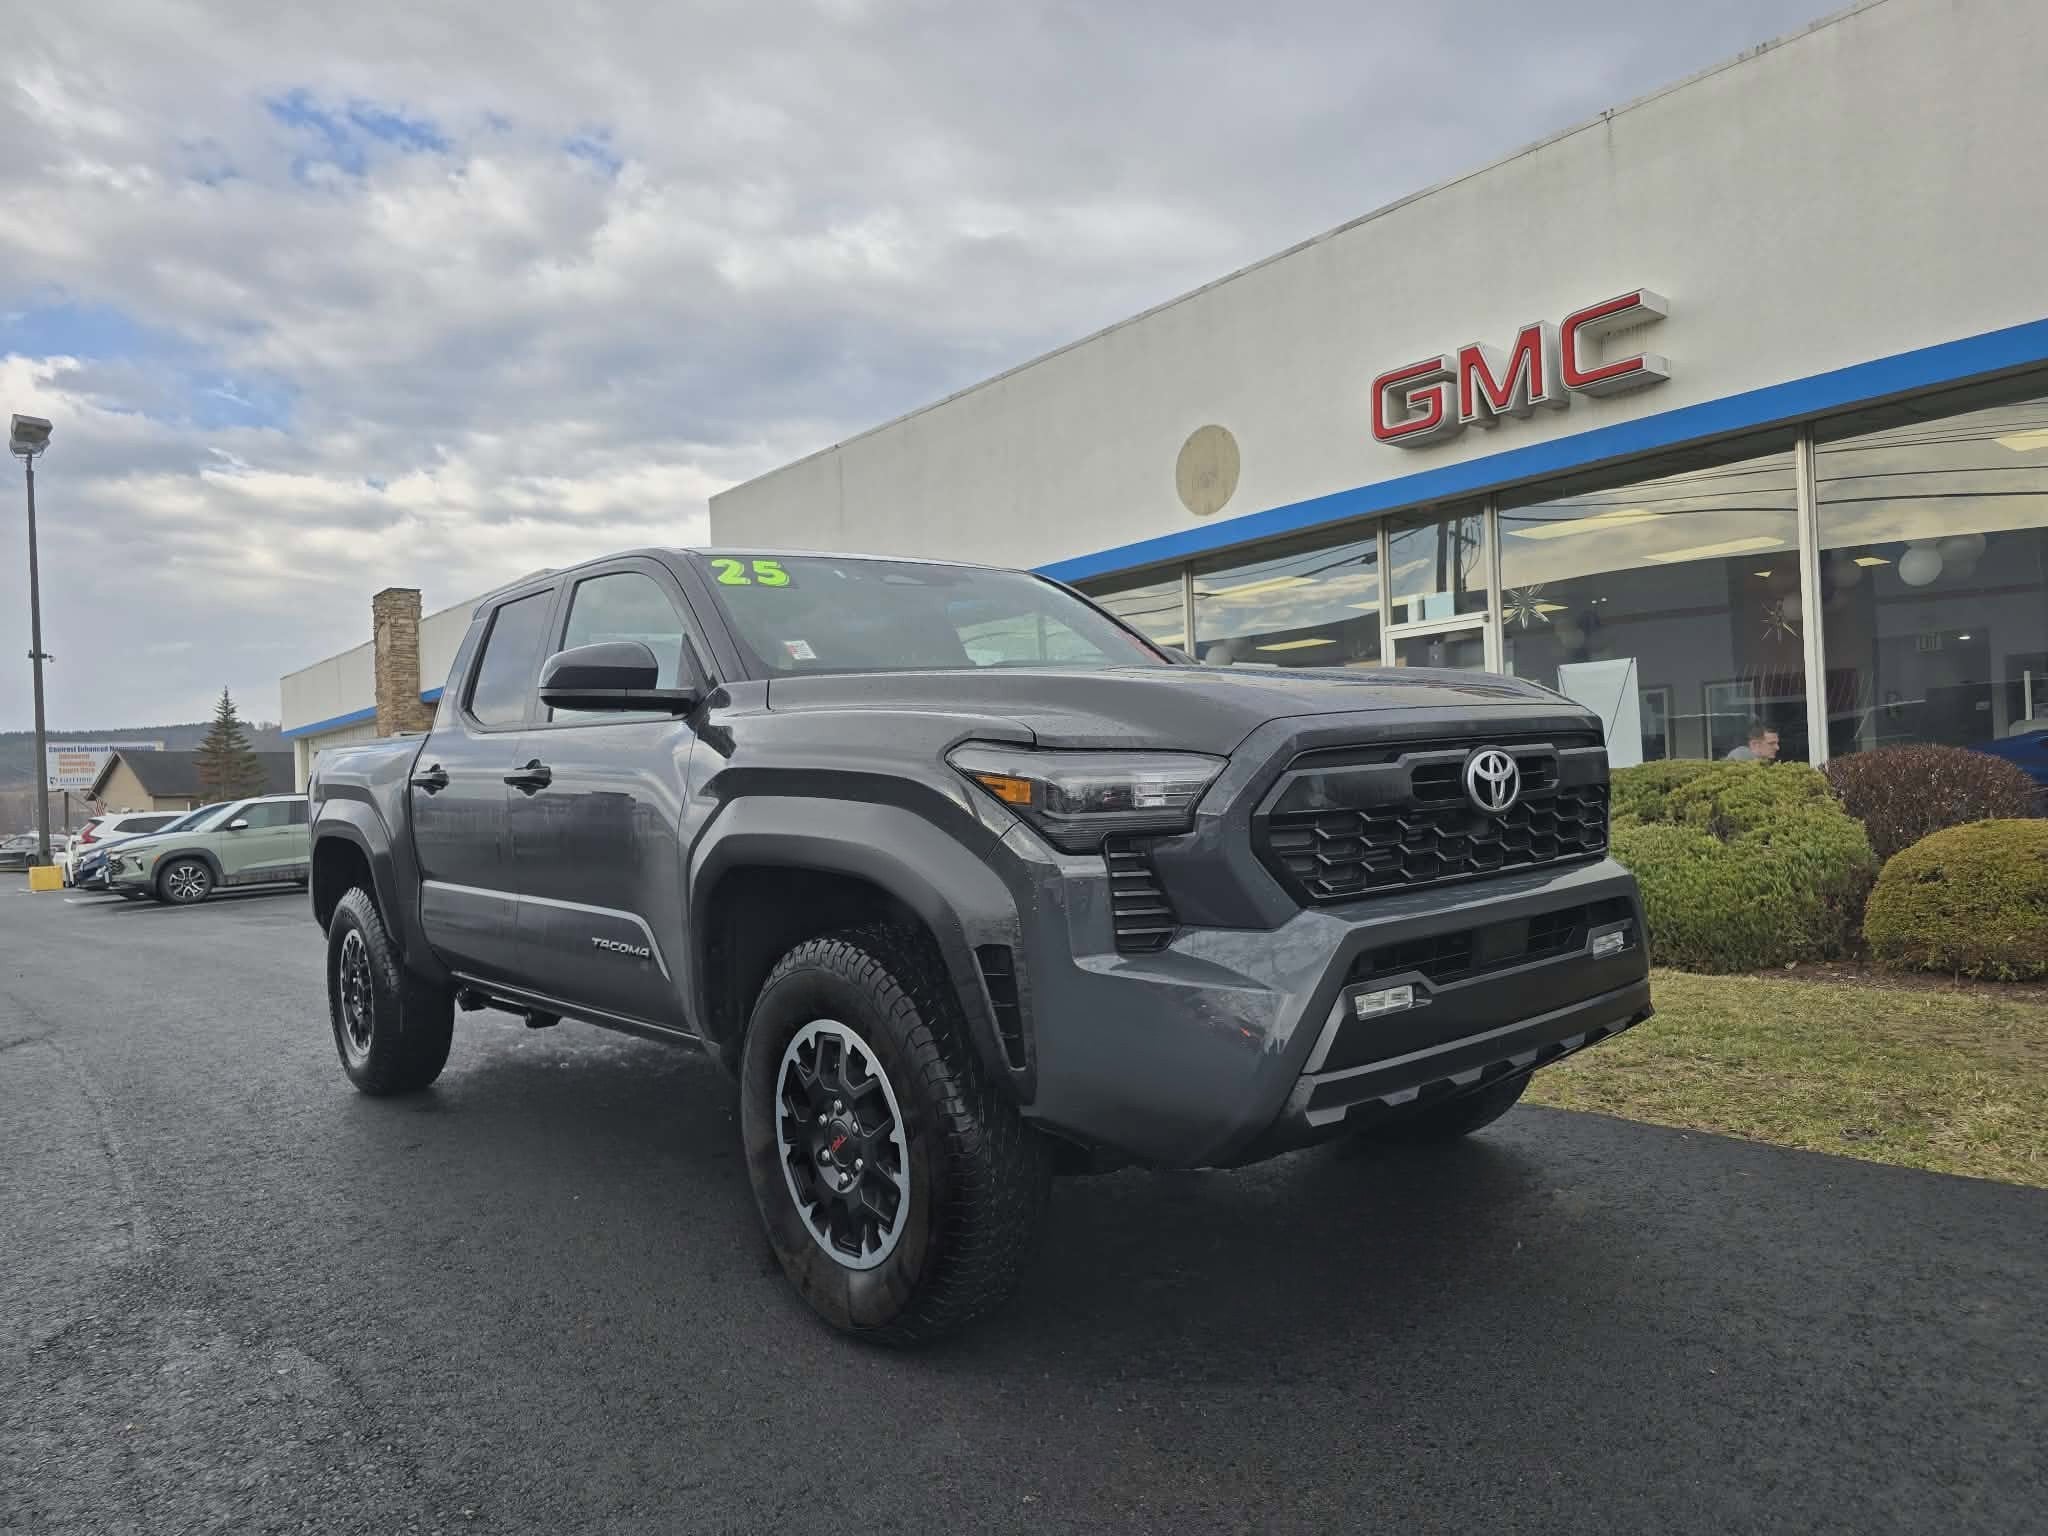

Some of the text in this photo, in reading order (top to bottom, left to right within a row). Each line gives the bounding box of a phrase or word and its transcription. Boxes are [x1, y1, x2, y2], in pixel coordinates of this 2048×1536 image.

[1370, 287, 1664, 448] GMC
[711, 558, 790, 587] 25
[591, 936, 650, 958] TACOMA
